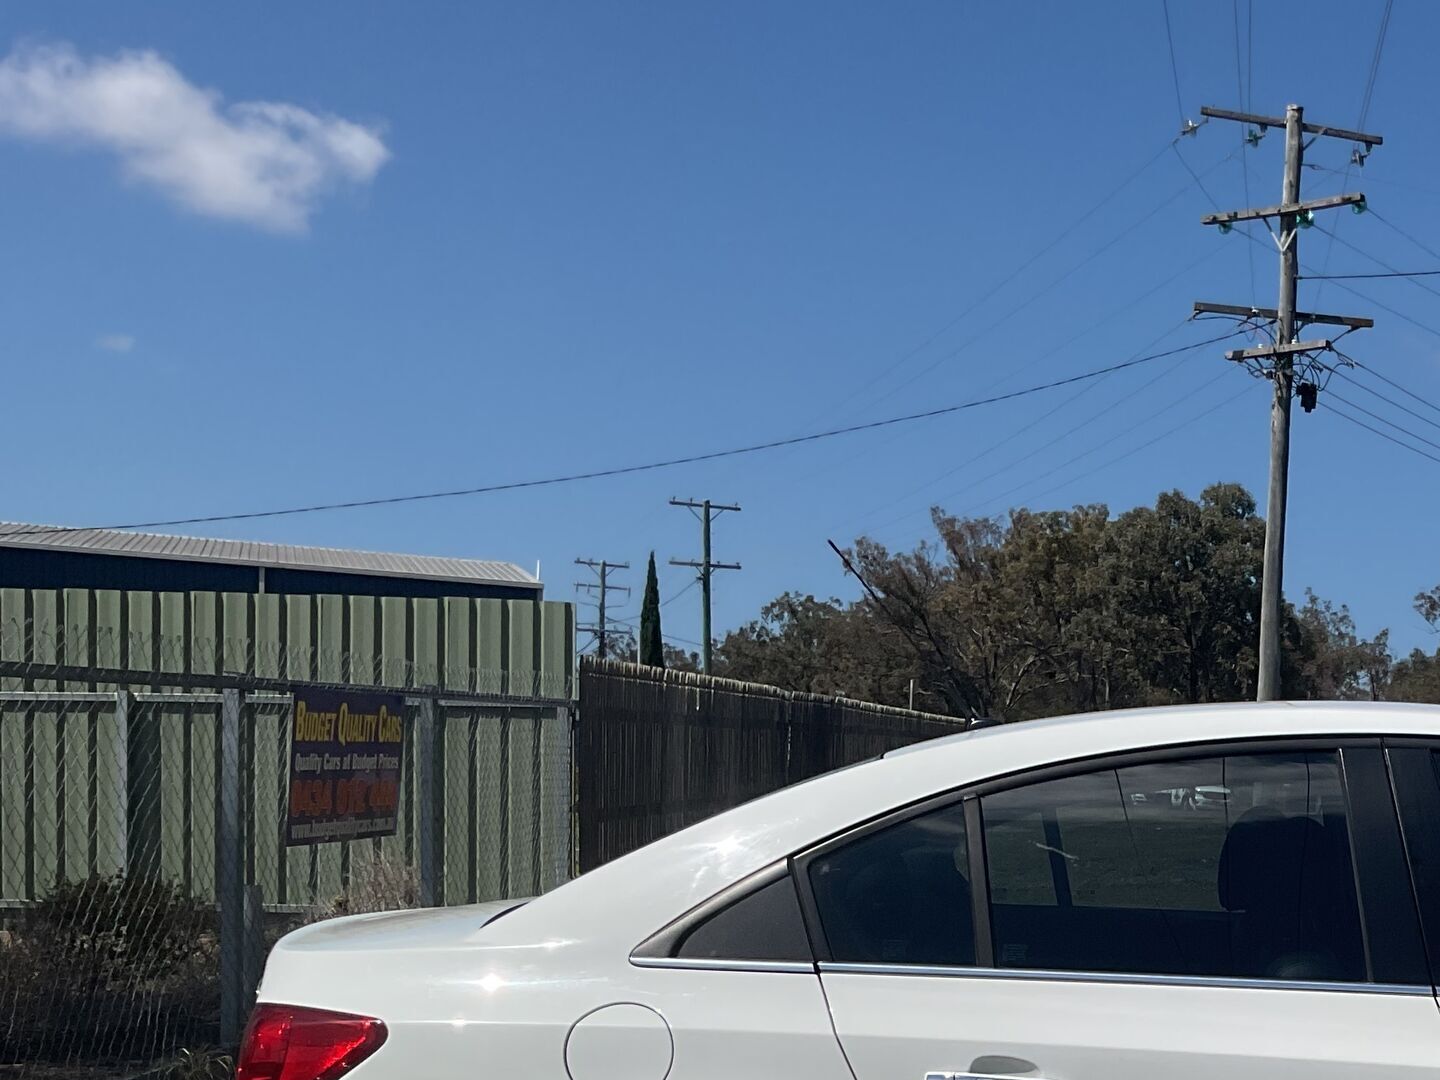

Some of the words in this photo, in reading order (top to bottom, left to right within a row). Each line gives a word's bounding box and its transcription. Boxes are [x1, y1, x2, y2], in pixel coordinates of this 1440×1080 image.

[295, 701, 337, 741] BUDGET
[338, 702, 378, 746] QUALITY
[378, 705, 403, 742] CARS
[295, 753, 322, 775] Quality
[324, 753, 341, 770] Cars
[352, 754, 377, 773] Budget
[378, 754, 399, 770] Prices
